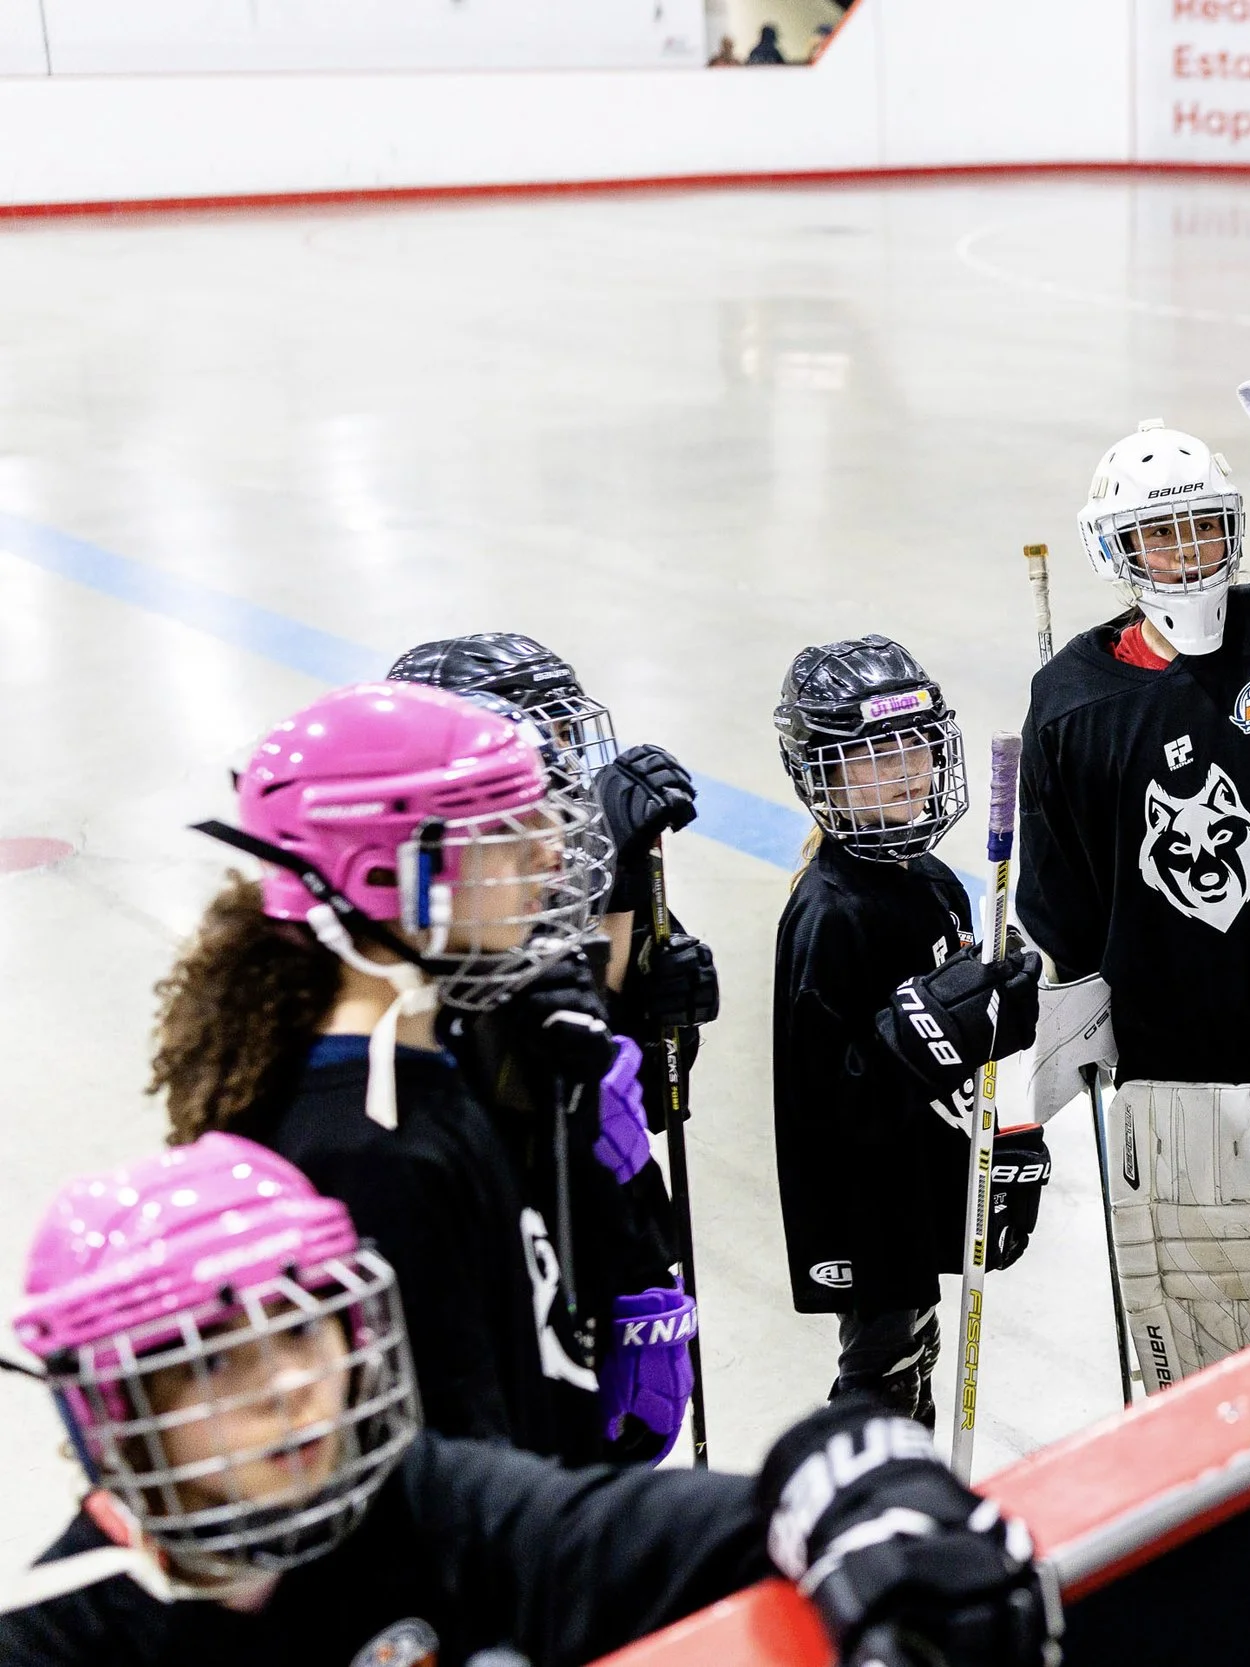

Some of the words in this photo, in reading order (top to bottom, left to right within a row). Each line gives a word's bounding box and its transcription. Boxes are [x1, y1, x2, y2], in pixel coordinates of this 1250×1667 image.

[1147, 482, 1205, 499] BAUER
[1124, 1102, 1134, 1179] REACTOR
[622, 1306, 698, 1346] KNA
[960, 1288, 983, 1431] FISCHER
